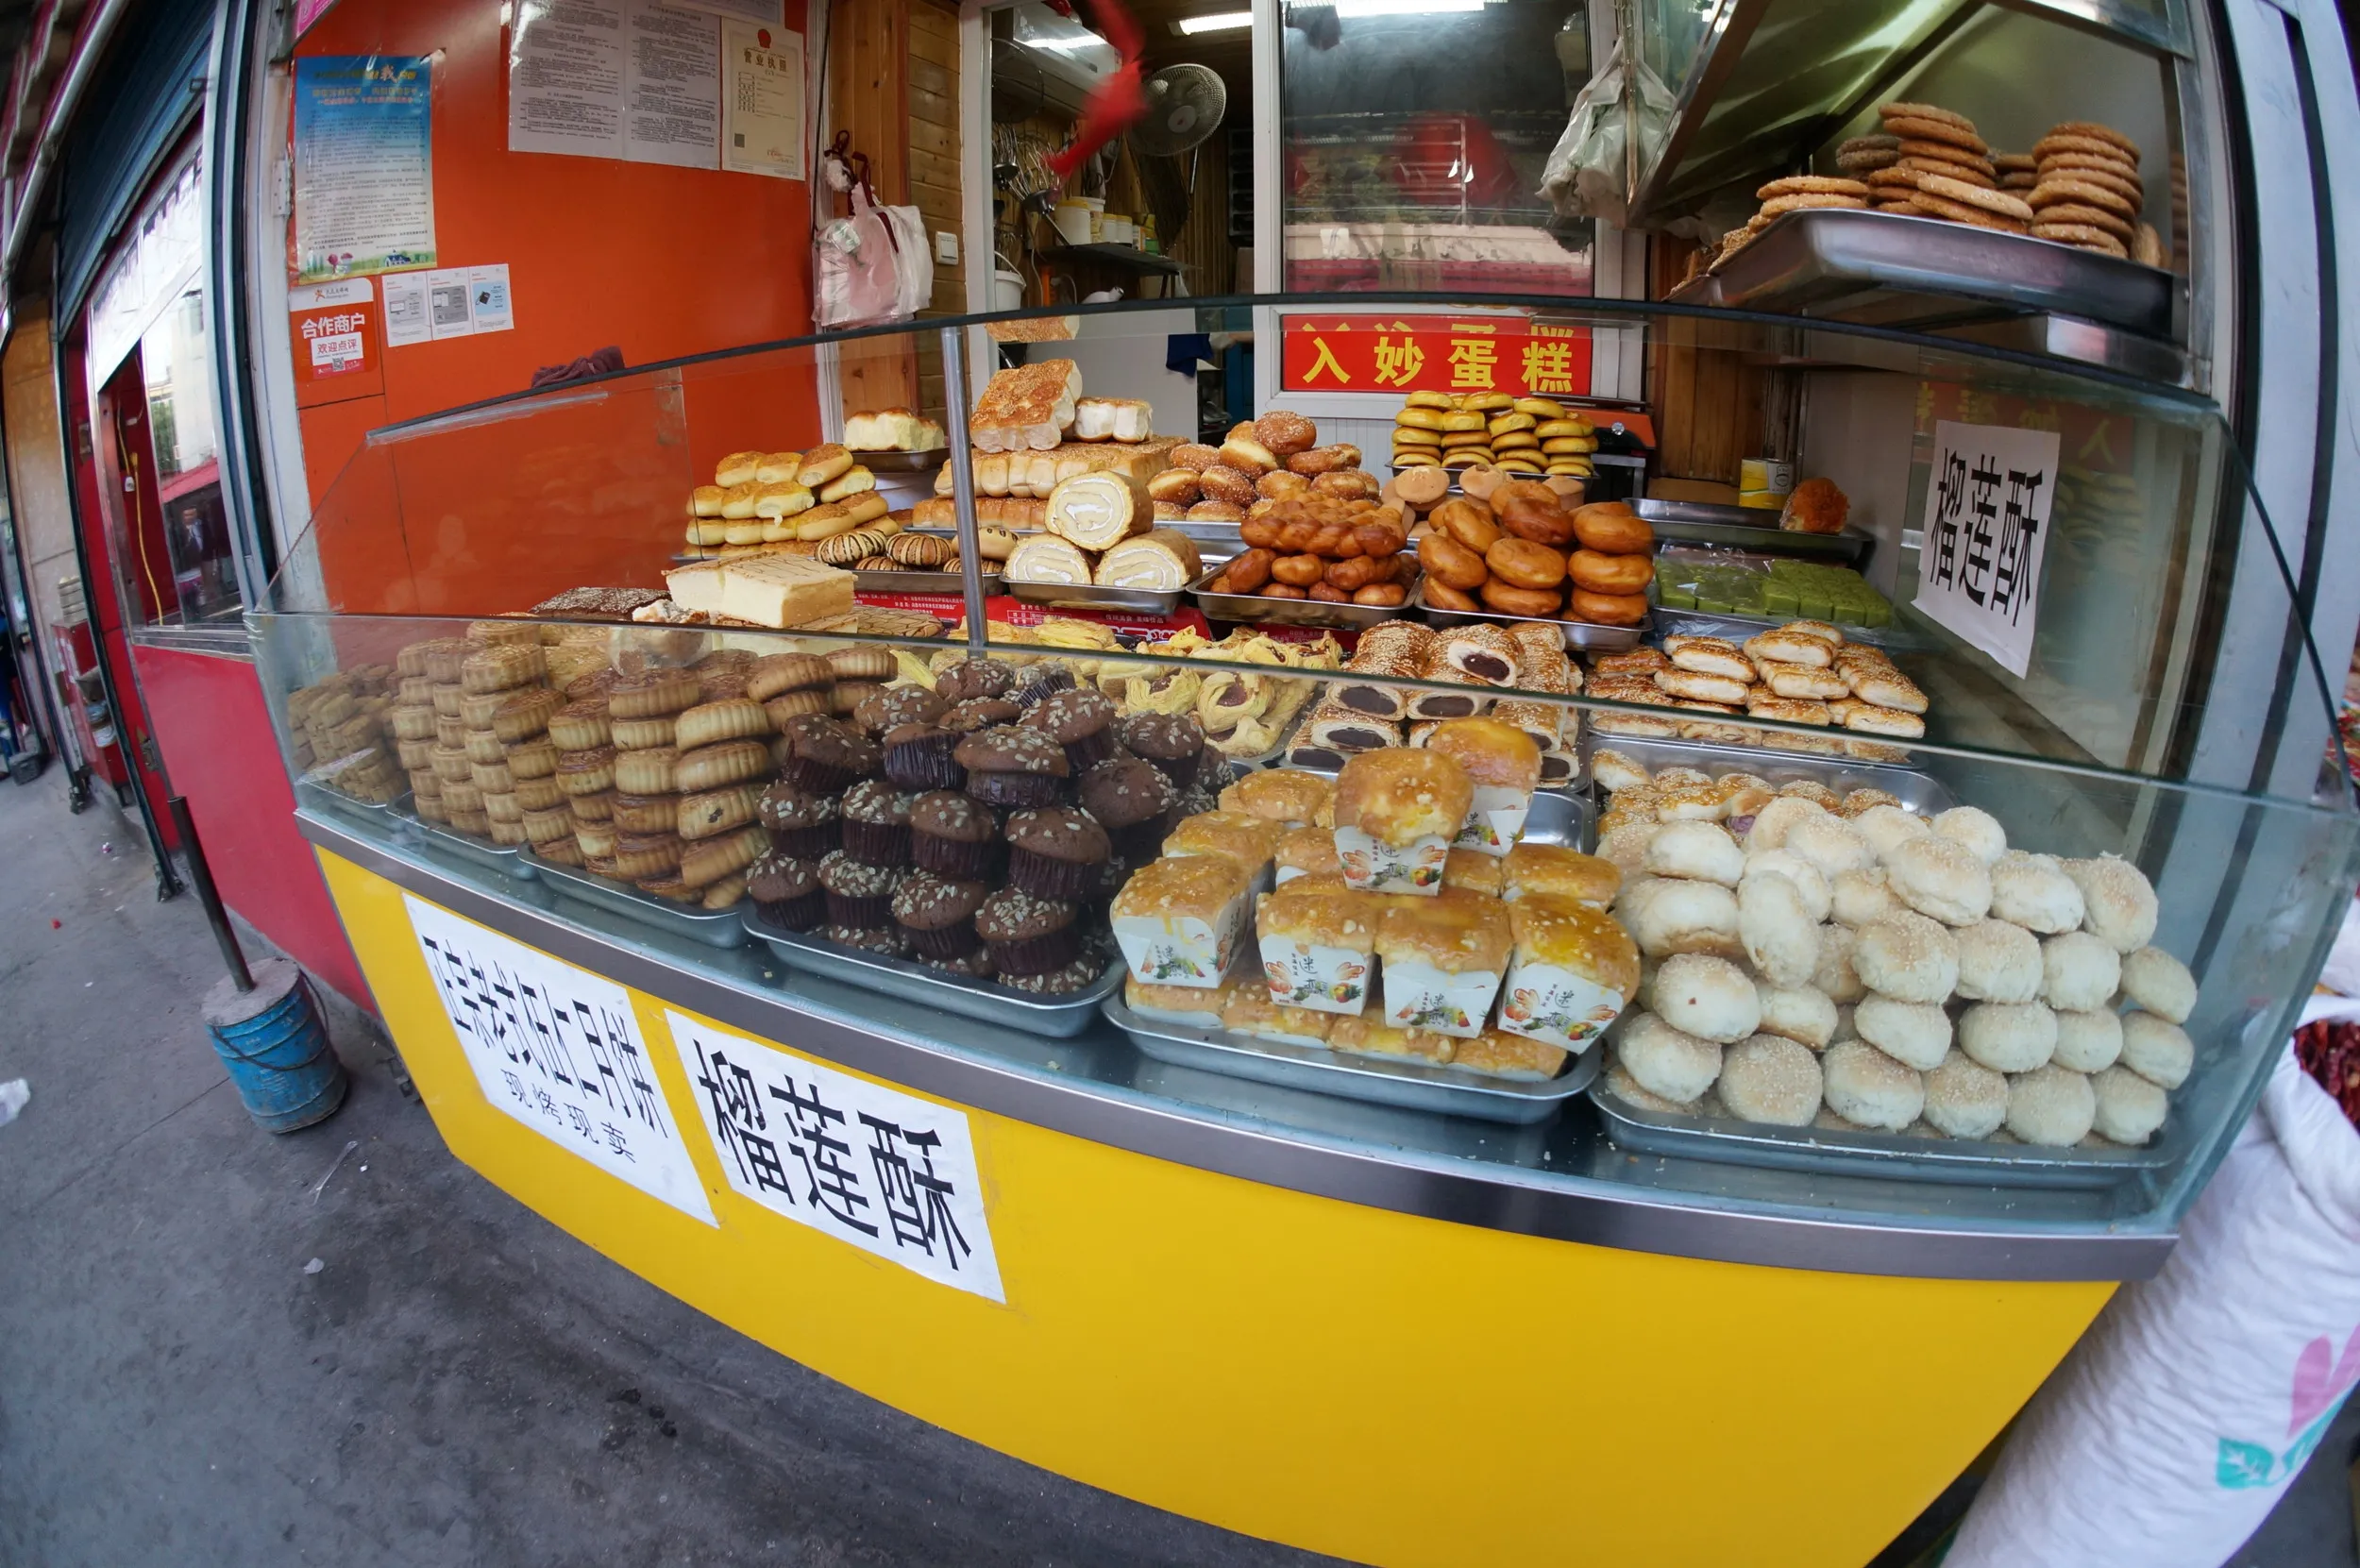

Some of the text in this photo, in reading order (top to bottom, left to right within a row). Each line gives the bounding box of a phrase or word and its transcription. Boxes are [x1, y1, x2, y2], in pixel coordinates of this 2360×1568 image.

[743, 49, 787, 73] 营业执照
[301, 312, 365, 340] 合作商户
[317, 338, 358, 355] 欢迎点评
[1302, 336, 1574, 392] 入妙蛋糕
[1930, 447, 2044, 628] 榴莲酥
[421, 935, 668, 1138] 正宗老式伍仁月饼
[499, 1068, 636, 1164] 现烤现卖
[689, 1038, 973, 1272] 榴莲酥
